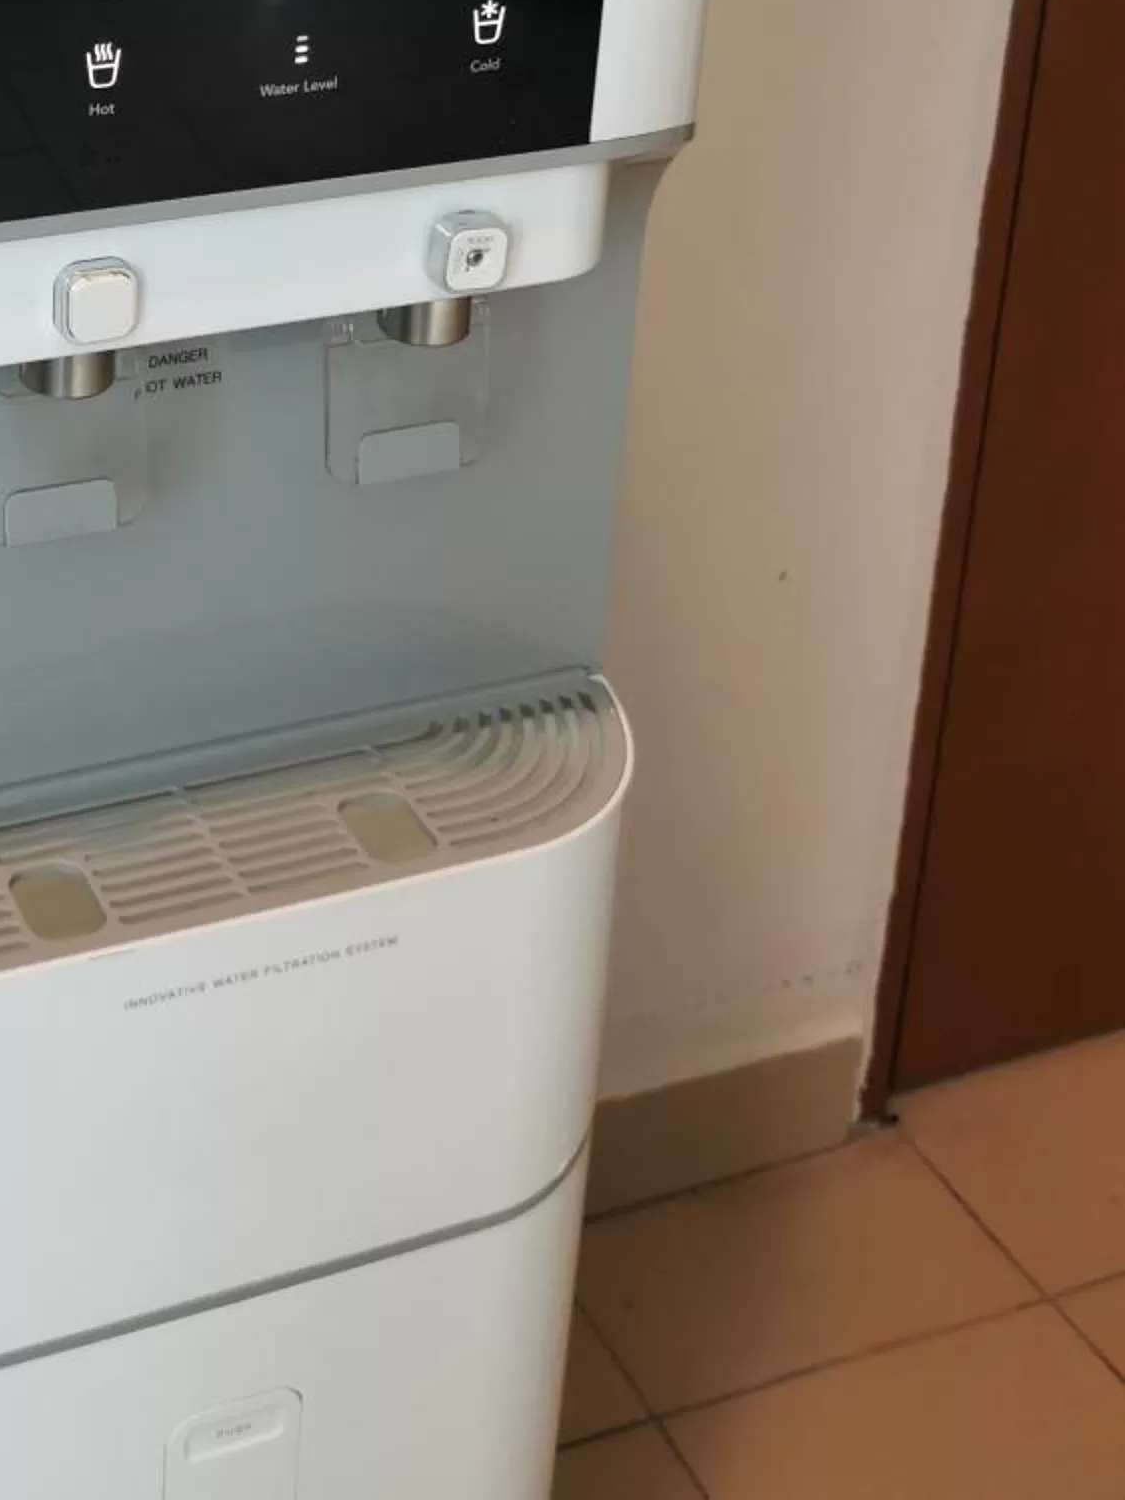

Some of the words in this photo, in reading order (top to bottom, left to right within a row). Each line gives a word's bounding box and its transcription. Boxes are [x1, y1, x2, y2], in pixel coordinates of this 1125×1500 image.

[470, 58, 501, 72] Cold
[260, 83, 300, 97] Water
[304, 75, 338, 93] Level
[88, 103, 115, 116] Hot
[148, 348, 208, 368] DANGER
[173, 372, 222, 389] WATER
[124, 981, 207, 1011] INNOVATIVE
[212, 969, 259, 989] WATER
[264, 949, 341, 977] FILTRATION
[344, 936, 399, 957] SYSTEM
